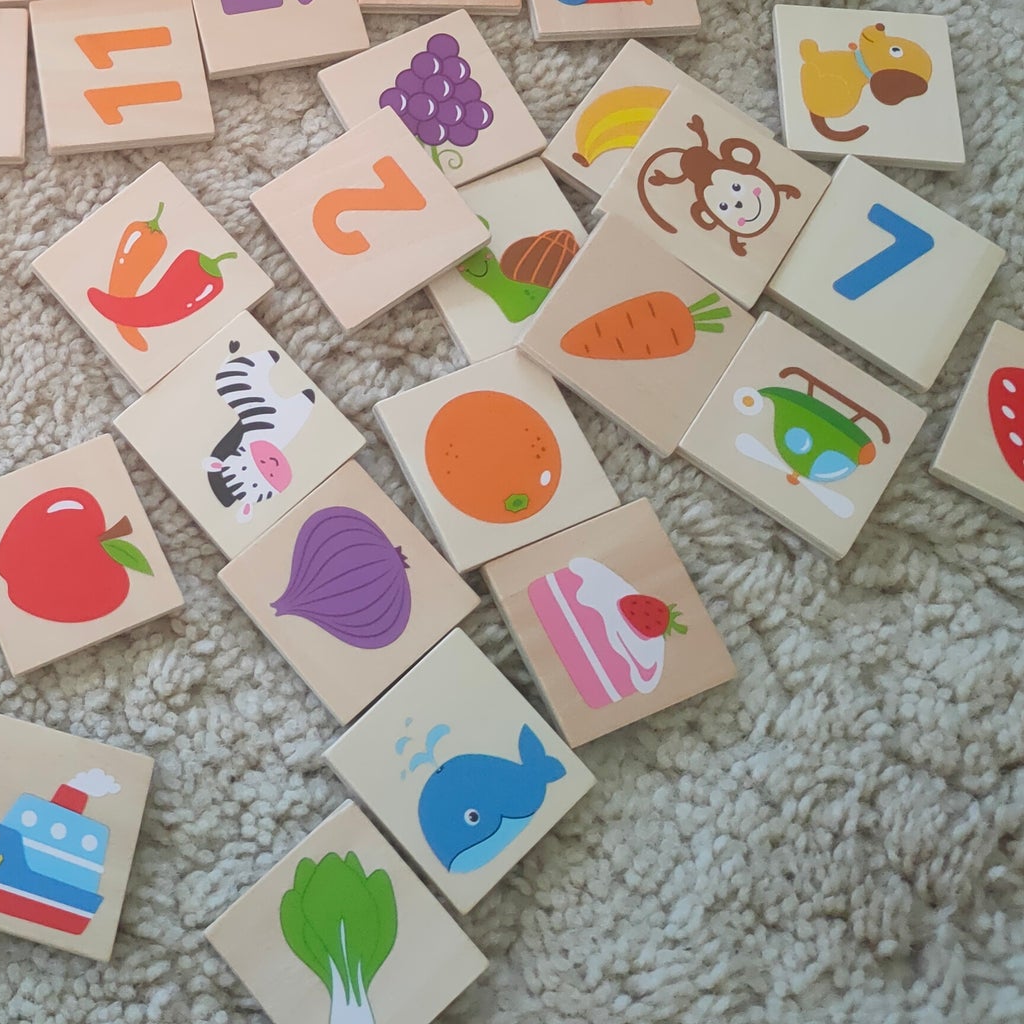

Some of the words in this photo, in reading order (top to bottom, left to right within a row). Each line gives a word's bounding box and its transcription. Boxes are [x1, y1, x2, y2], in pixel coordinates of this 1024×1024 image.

[74, 27, 183, 125] 11
[313, 156, 426, 256] 2
[833, 203, 935, 301] 7
